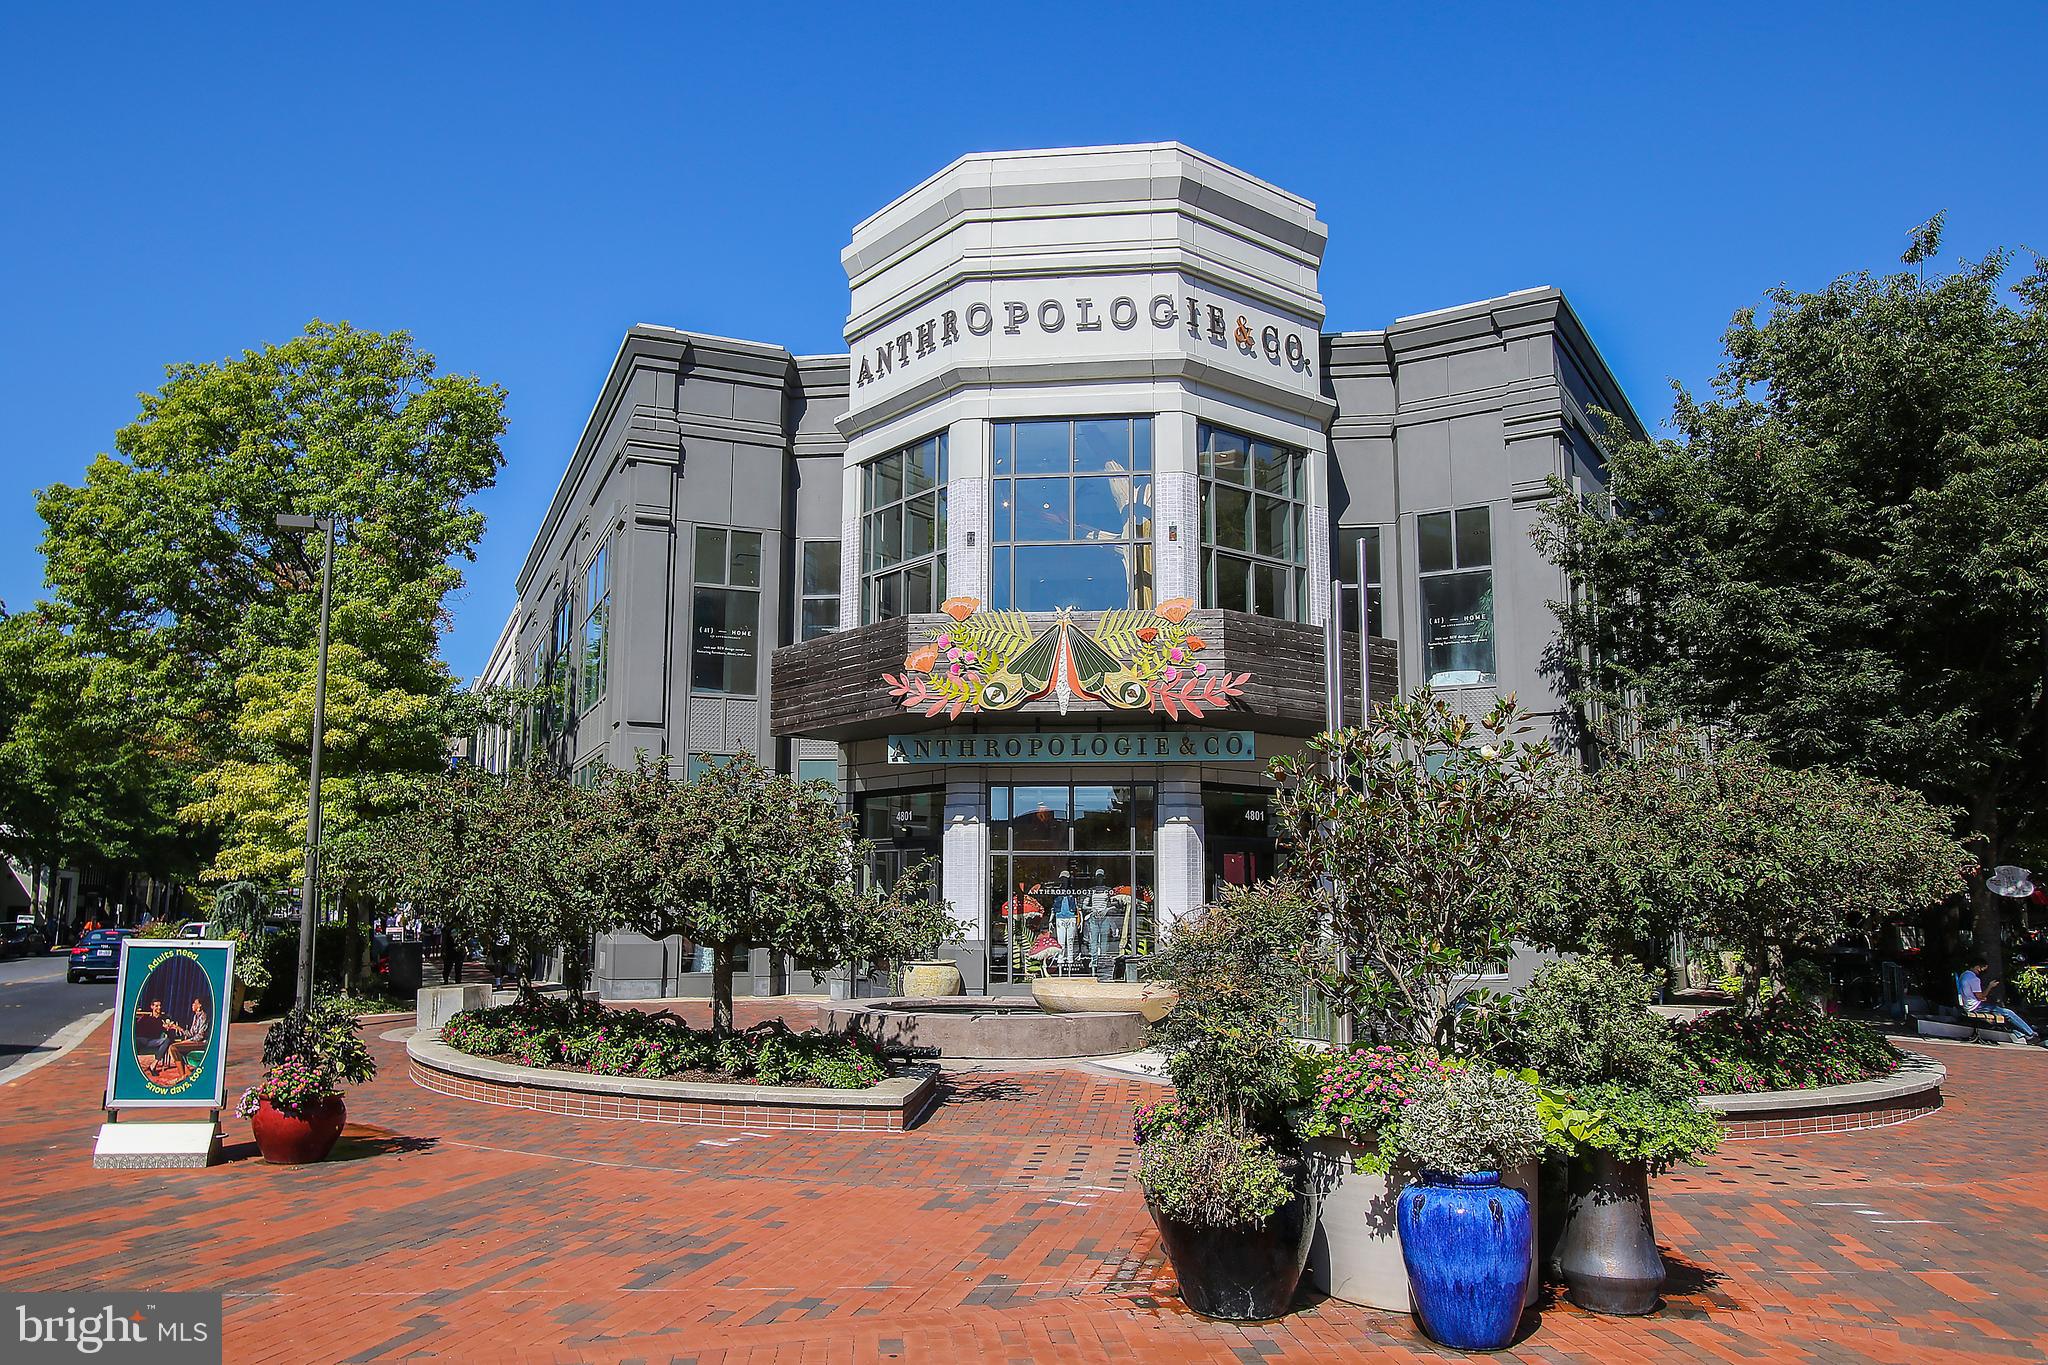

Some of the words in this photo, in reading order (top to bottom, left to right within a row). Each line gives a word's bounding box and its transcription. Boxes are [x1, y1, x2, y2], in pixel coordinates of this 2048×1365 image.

[896, 811, 913, 821] 4801
[1245, 810, 1264, 821] 4801
[148, 950, 174, 972] Adults
[176, 949, 198, 961] need
[145, 1082, 168, 1095] snow
[170, 1082, 192, 1095] days,
[190, 1066, 204, 1082] too.
